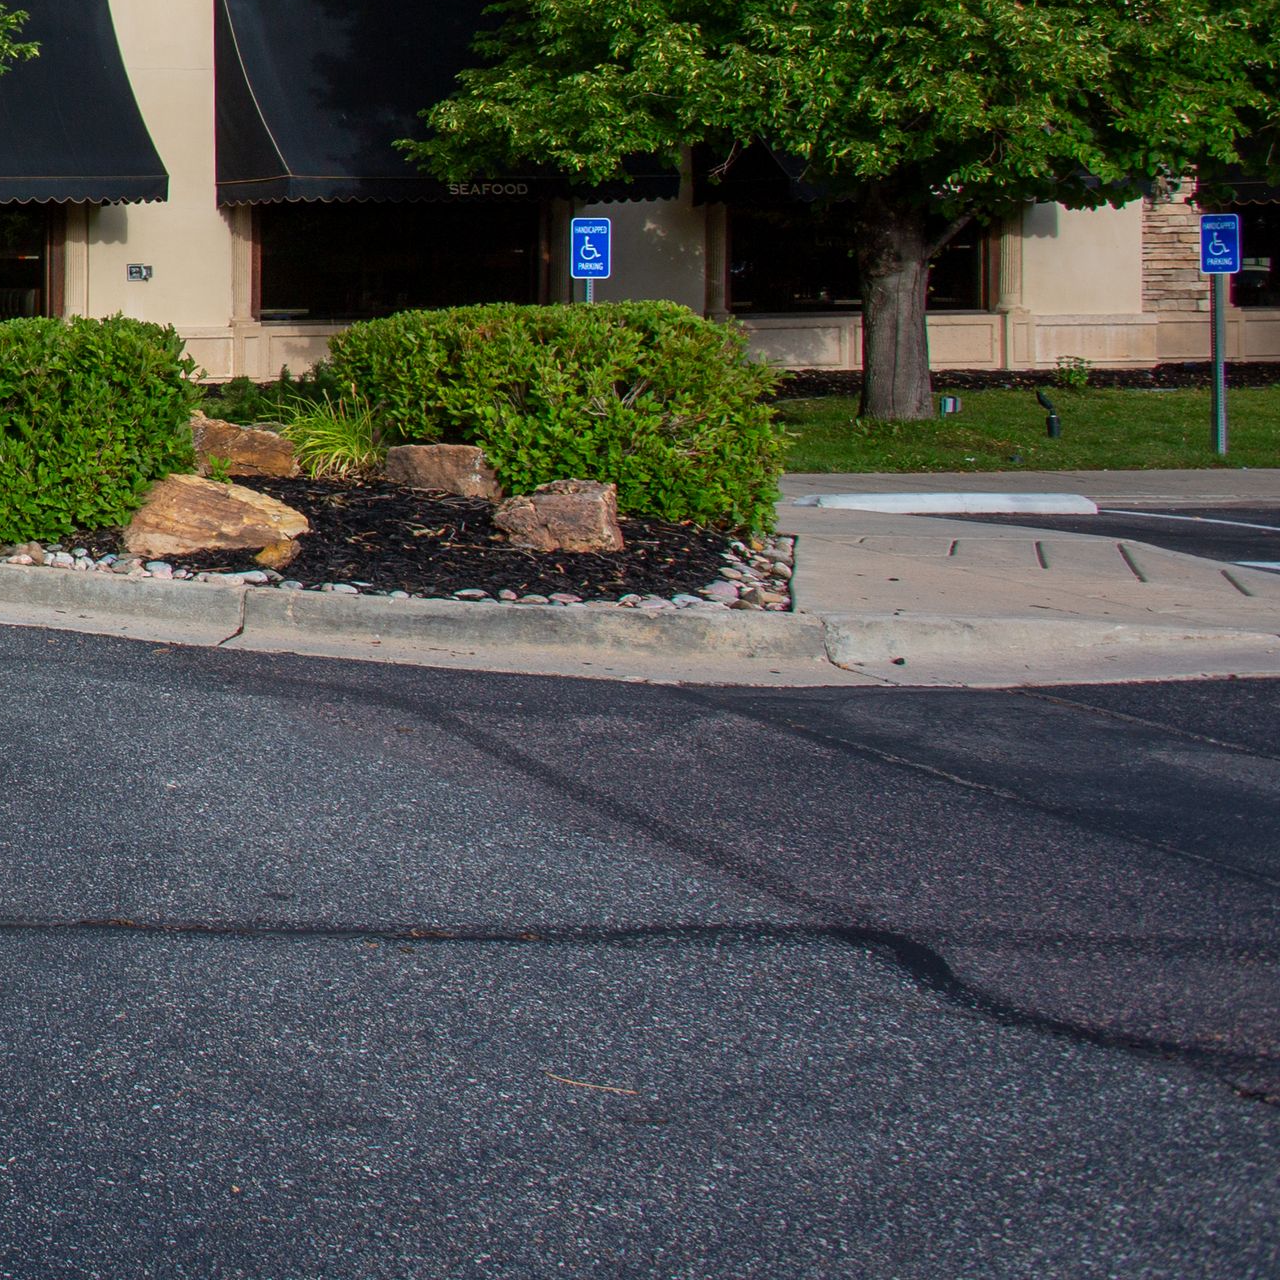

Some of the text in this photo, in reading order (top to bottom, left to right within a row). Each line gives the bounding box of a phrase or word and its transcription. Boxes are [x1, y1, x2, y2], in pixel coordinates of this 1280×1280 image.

[448, 183, 529, 195] SEAFOOD
[574, 225, 608, 234] HANDICAPPED
[1206, 257, 1233, 266] PARKING
[578, 262, 604, 271] PARKING
